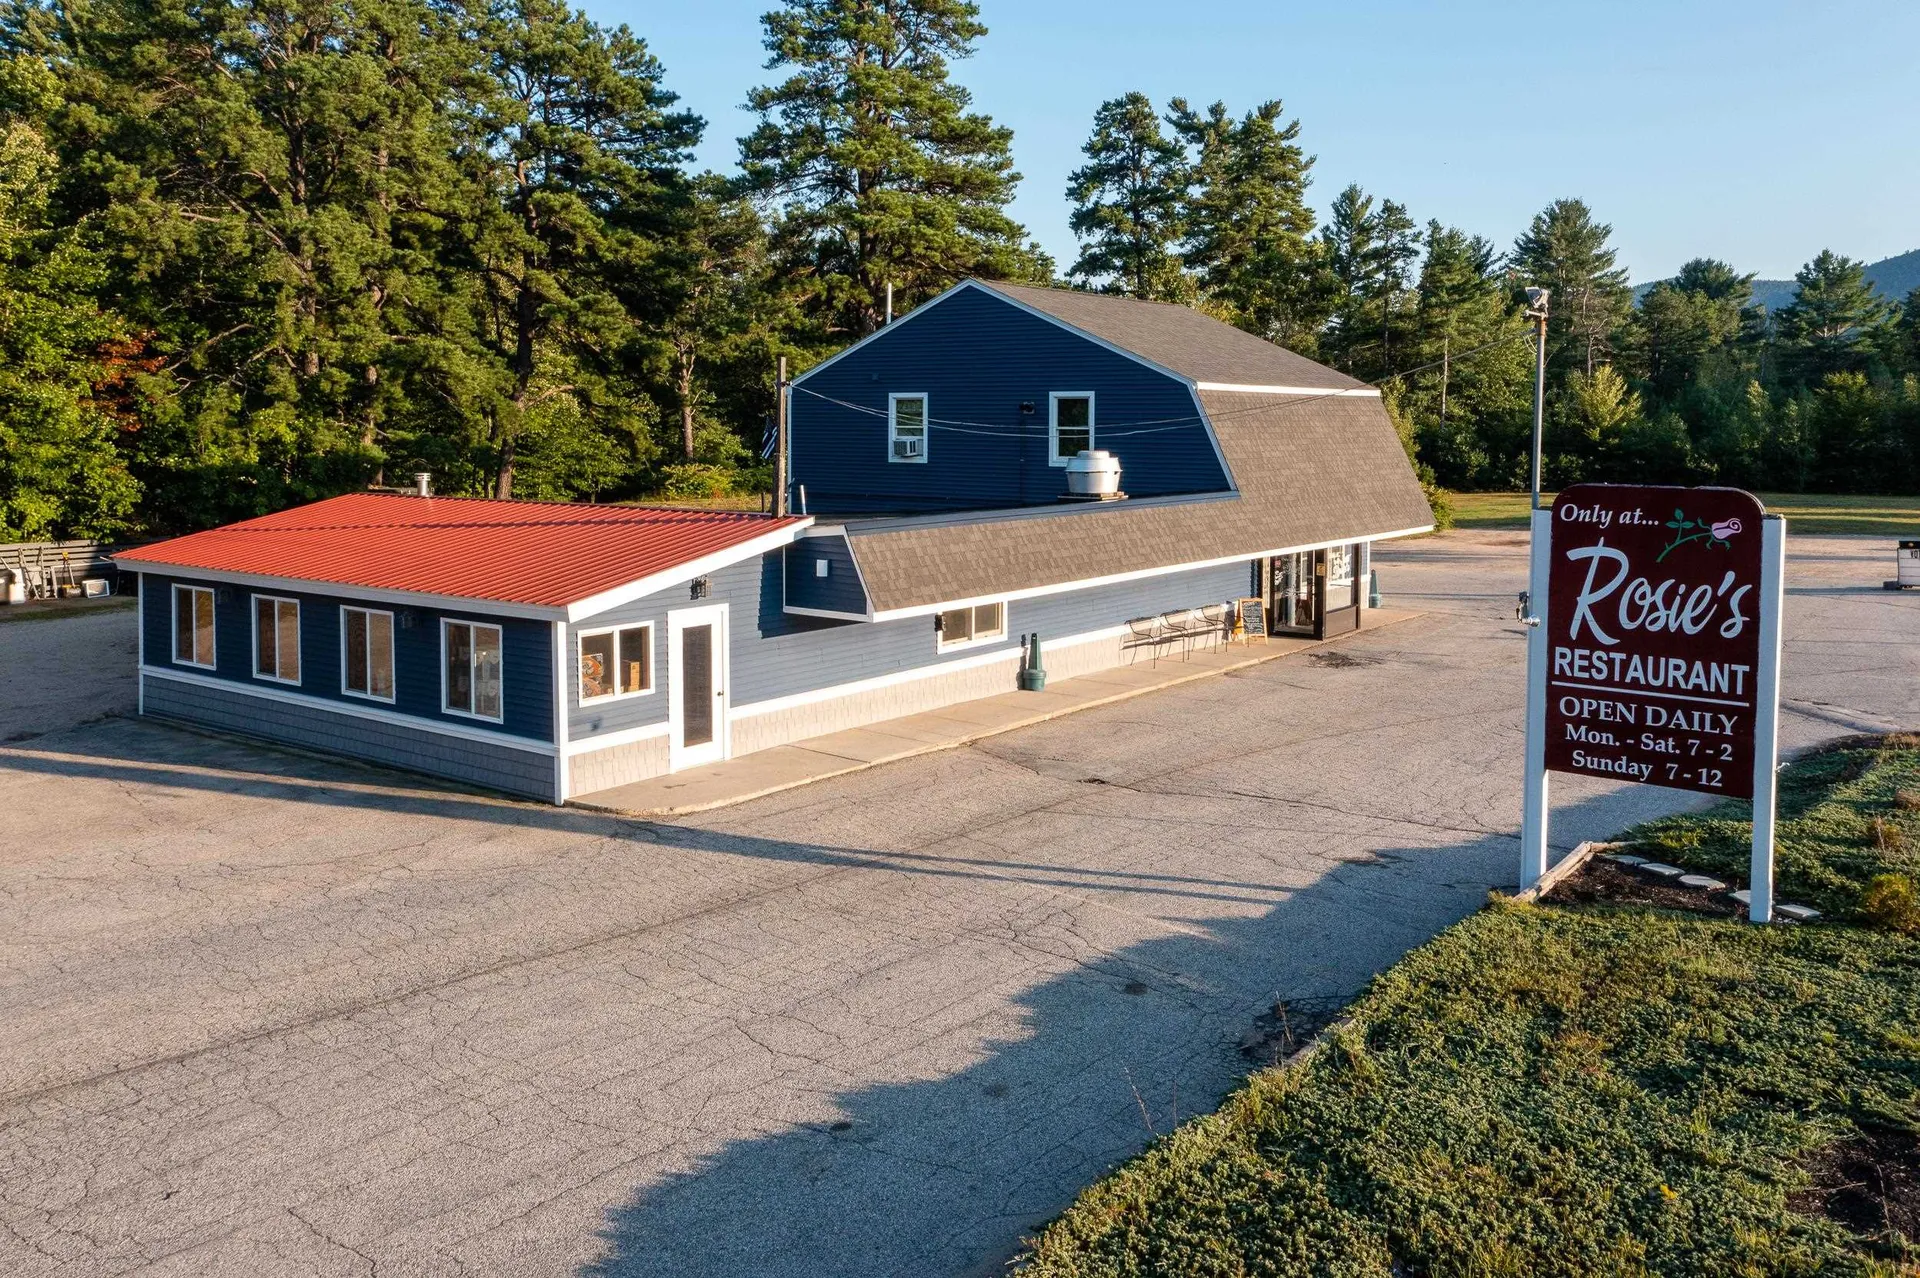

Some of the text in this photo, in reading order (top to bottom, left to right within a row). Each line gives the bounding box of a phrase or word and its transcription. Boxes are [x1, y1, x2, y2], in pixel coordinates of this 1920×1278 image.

[1560, 503, 1659, 529] Only at...
[1566, 536, 1753, 646] Rosie's
[1553, 646, 1750, 695] RESTAURANT
[1559, 696, 1738, 736] OPEN DAILY
[1564, 722, 1621, 747] Mon.
[1640, 732, 1681, 755] Sat.
[1687, 739, 1701, 756] 7
[1719, 743, 1733, 761] 2
[1572, 749, 1654, 782] Sunday
[1665, 763, 1679, 780] 7
[1697, 767, 1723, 787] 12
